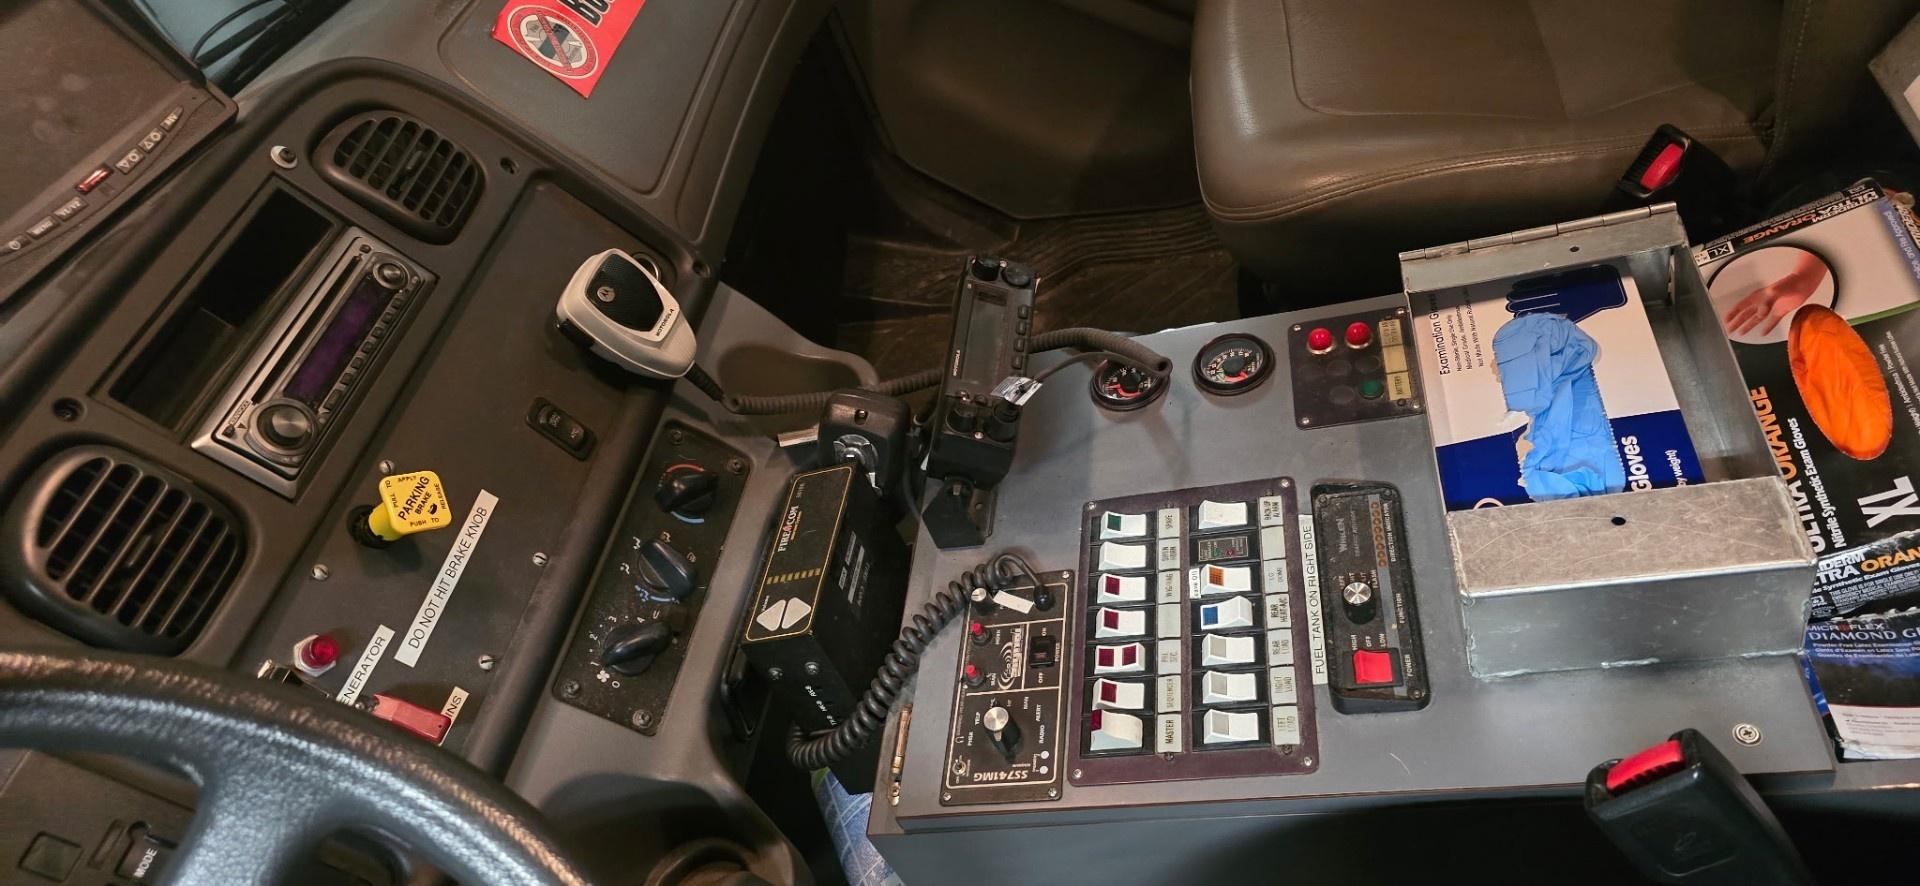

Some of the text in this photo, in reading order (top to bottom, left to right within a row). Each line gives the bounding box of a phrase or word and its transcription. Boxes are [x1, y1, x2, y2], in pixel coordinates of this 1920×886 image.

[1744, 213, 1817, 243] ORANGE
[1709, 244, 1729, 259] XL
[656, 308, 675, 337] MOTOROLA
[1432, 320, 1450, 375] Examination
[1394, 375, 1403, 395] BATTERY
[1751, 386, 1797, 480] ORANGE
[1621, 435, 1652, 492] Gloves
[1664, 449, 1683, 477] weight)
[385, 480, 391, 488] TO
[398, 475, 417, 483] APPLY
[1788, 417, 1847, 549] Nitrile Synthetic Exam Gloves
[398, 476, 430, 520] PARKING
[410, 519, 427, 527] PUSH
[434, 483, 447, 509] RELEASE
[414, 491, 432, 515] BRAKE
[1272, 501, 1280, 518] ALARM
[1857, 475, 1920, 529] XL
[1383, 502, 1396, 562] DIRECTION INDICATOR
[408, 506, 488, 649] DO NOT HIT BRAKE KNOB
[1822, 577, 1863, 593] Synthetic
[1271, 603, 1279, 618] REAR
[1302, 525, 1325, 674] FUEL TANK ON RIGHT SIDE
[1396, 593, 1405, 624] FUNCTION
[608, 615, 617, 623] 3
[589, 631, 599, 641] 2
[1272, 639, 1281, 655] REAR
[1350, 634, 1358, 651] HIGH
[1808, 631, 1897, 641] DIAMOND
[1404, 653, 1413, 677] POWER
[1165, 719, 1174, 744] MASTER
[973, 769, 1028, 782] SS741MG
[134, 847, 158, 878] MODE
